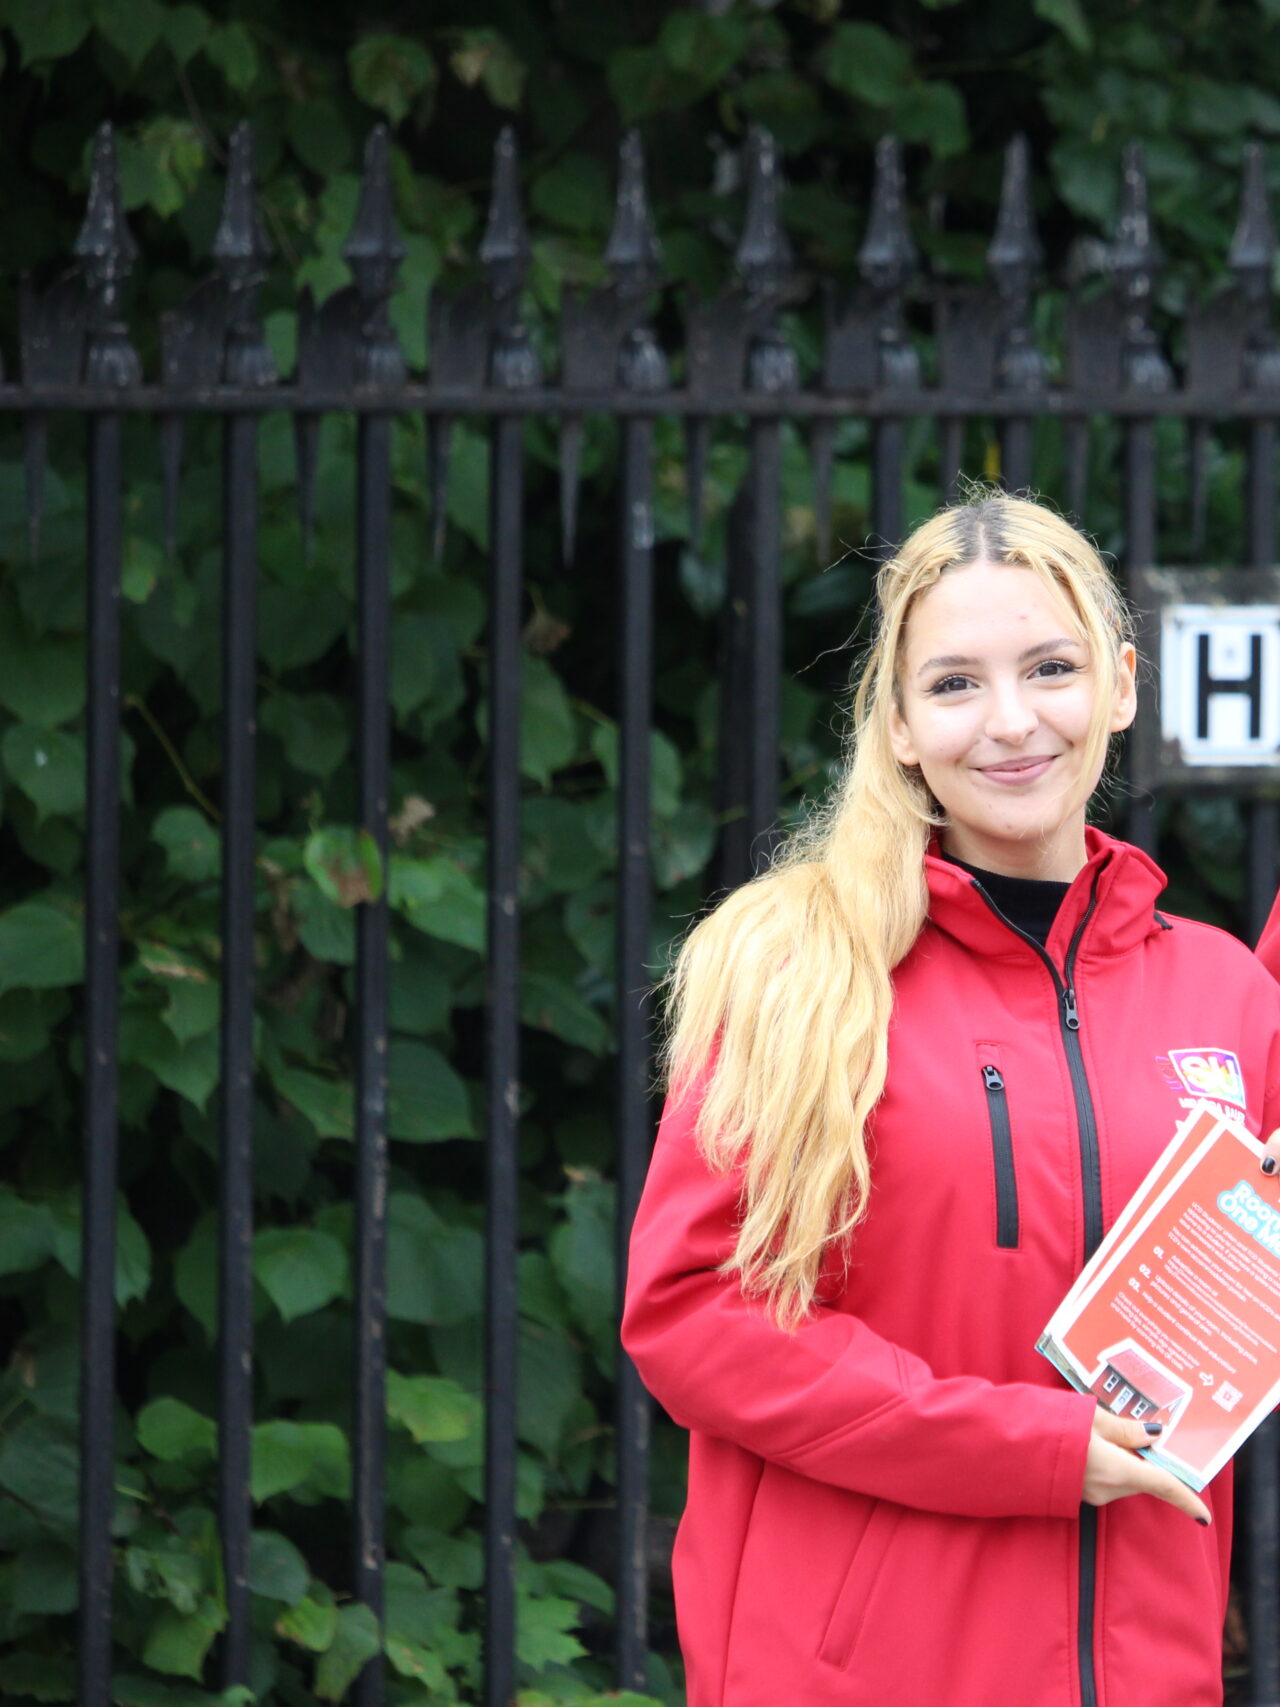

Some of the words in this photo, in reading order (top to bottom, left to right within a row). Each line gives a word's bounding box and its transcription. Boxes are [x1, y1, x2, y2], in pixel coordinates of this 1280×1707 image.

[1197, 633, 1262, 739] H
[1220, 1192, 1260, 1232] One
[1152, 1245, 1167, 1260] 01.
[1137, 1262, 1154, 1279] 02.
[1127, 1276, 1144, 1293] 03.
